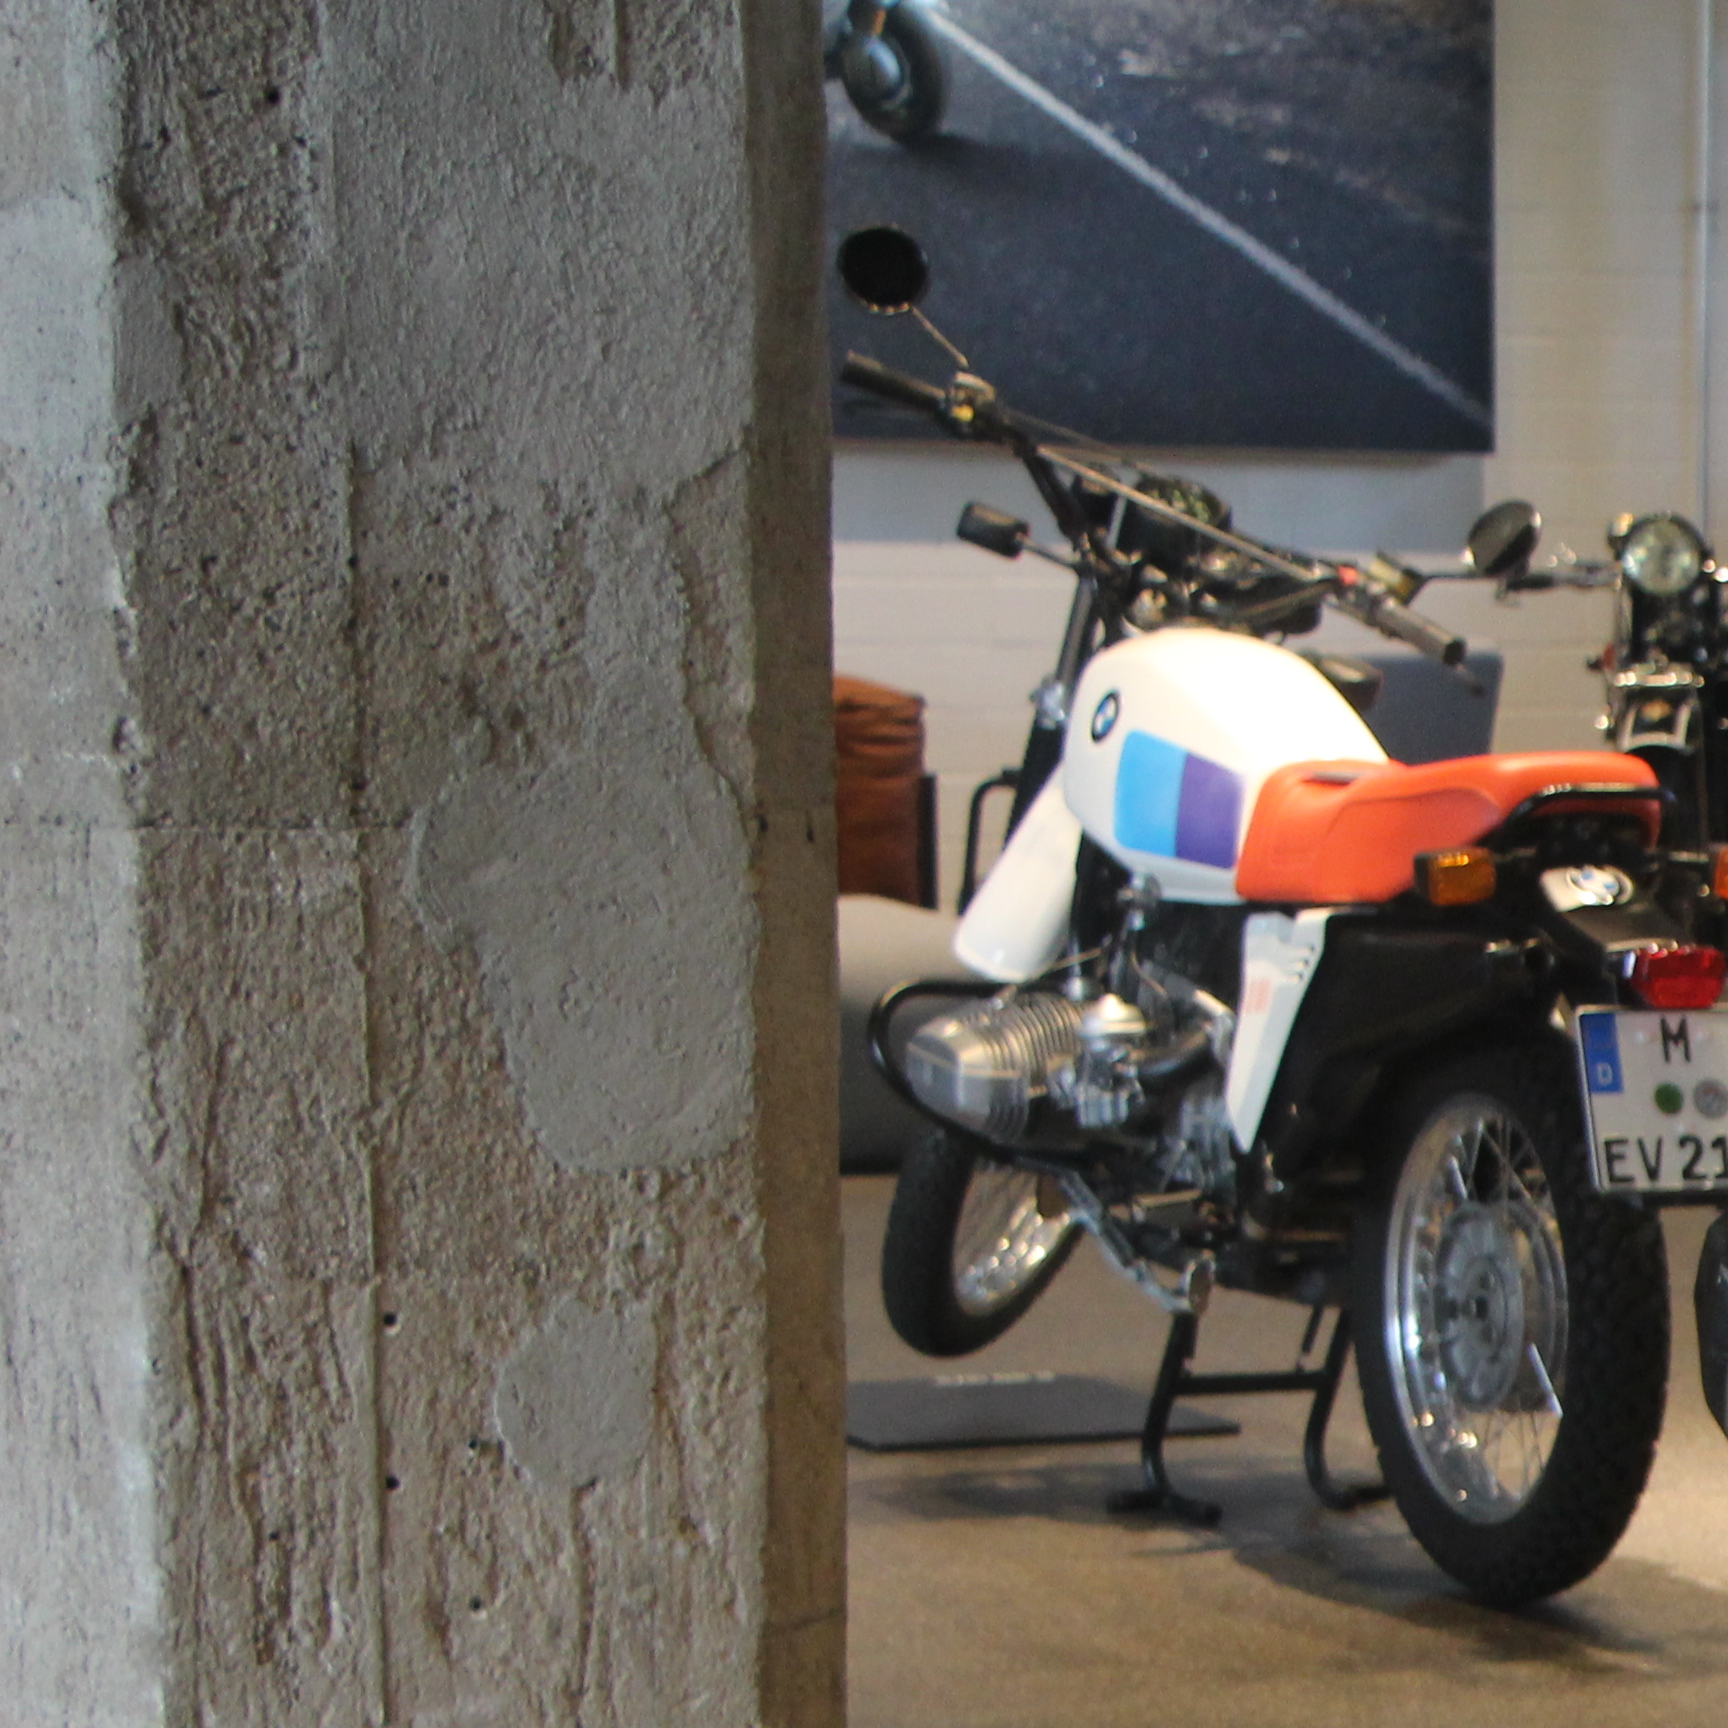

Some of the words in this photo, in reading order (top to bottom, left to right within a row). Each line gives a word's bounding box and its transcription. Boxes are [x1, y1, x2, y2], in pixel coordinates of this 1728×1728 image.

[1660, 1016, 1691, 1063] M
[1598, 1062, 1614, 1085] D
[1603, 1136, 1663, 1183] EV
